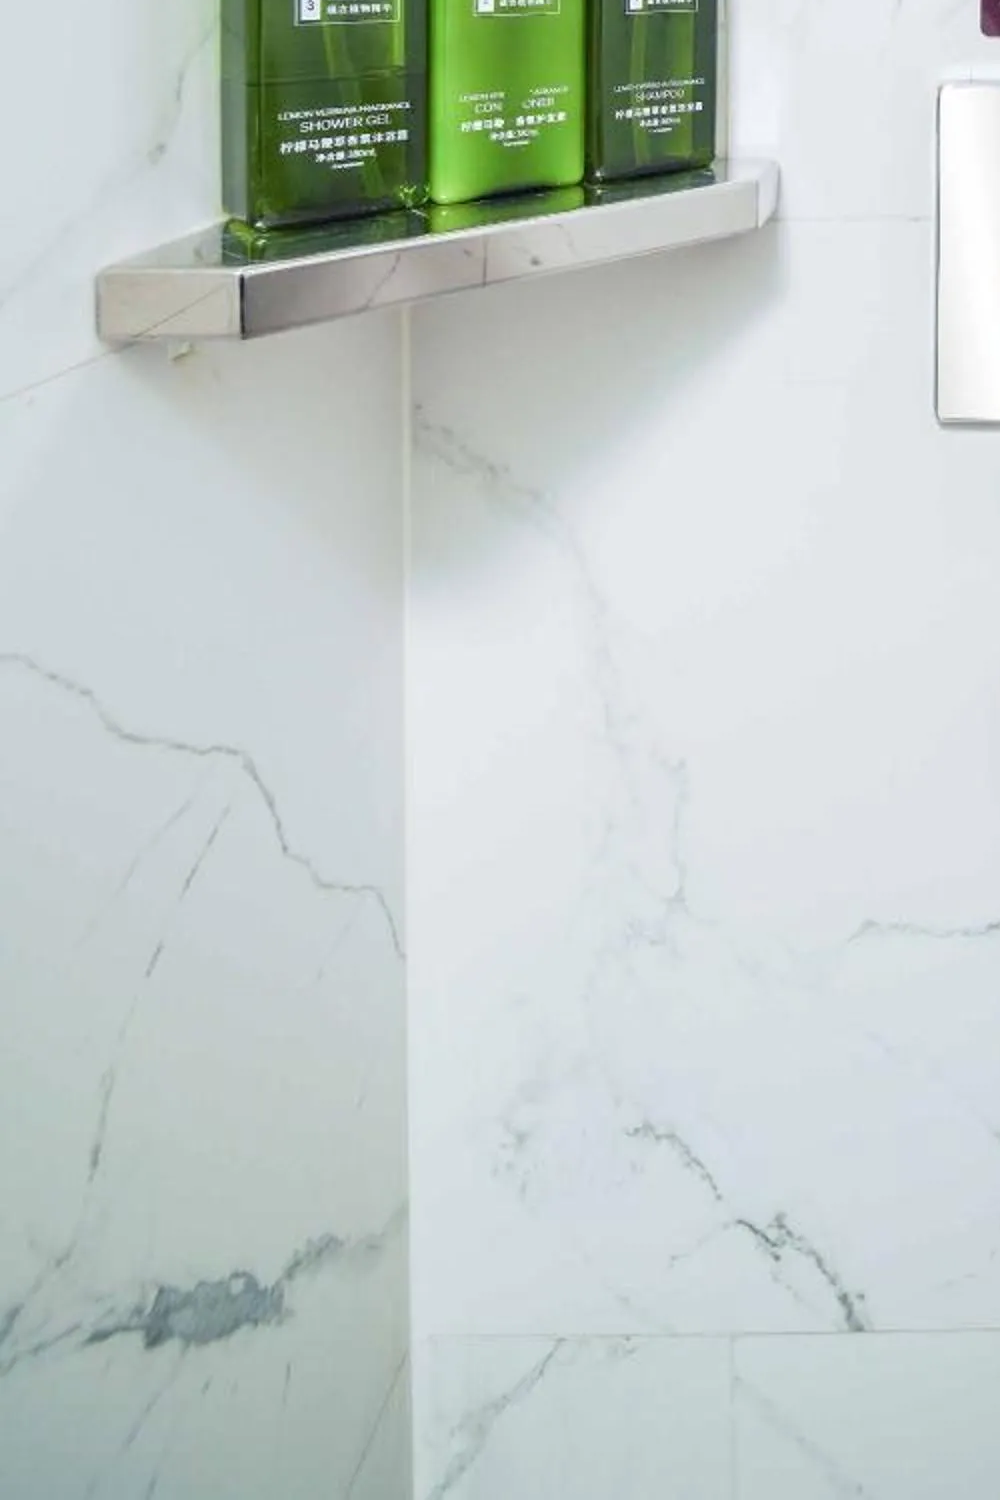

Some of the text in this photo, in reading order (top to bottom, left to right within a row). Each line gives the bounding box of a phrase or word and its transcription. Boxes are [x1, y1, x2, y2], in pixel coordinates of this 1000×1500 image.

[306, 0, 315, 11] 3
[299, 113, 392, 133] SHOWER GEL
